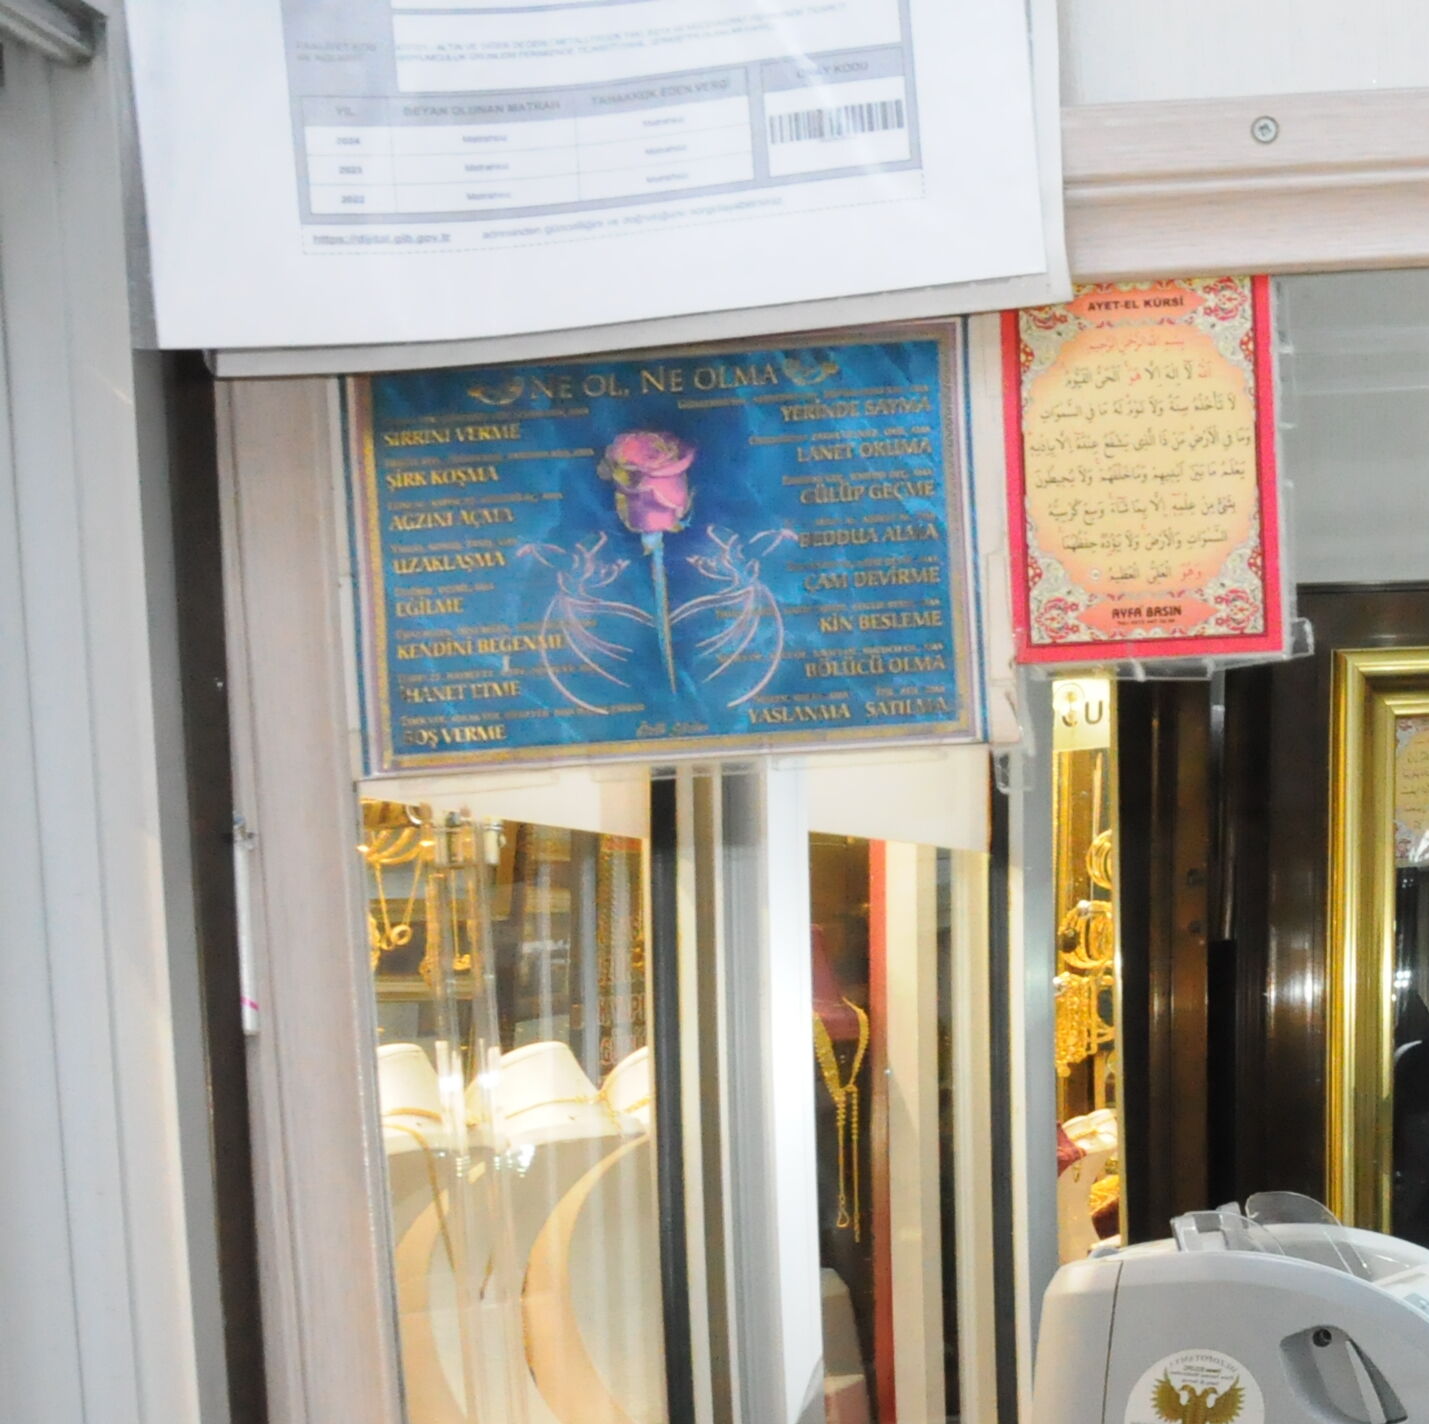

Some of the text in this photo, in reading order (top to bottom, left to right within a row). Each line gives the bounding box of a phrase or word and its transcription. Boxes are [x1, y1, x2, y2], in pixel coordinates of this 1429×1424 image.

[1087, 297, 1184, 312] AYET-EL KÜRSİ
[530, 376, 573, 399] NE
[640, 366, 683, 394] NE
[693, 363, 779, 391] OLMA
[779, 399, 860, 422] YERİNDE
[455, 423, 521, 443] VERME
[797, 437, 932, 462] LANET OKUMA
[386, 466, 498, 492] ŞİRK KOŞMA
[392, 551, 507, 575] UZAKLAŞMA
[854, 565, 941, 587] DEVİRME
[819, 610, 942, 633] KİN BESLEME
[397, 637, 473, 660] KENDİNİ
[805, 656, 883, 678] BÖLÜCÜ
[888, 653, 945, 673] OLMA
[749, 703, 850, 725] YASLANMA
[442, 724, 507, 744] VERME
